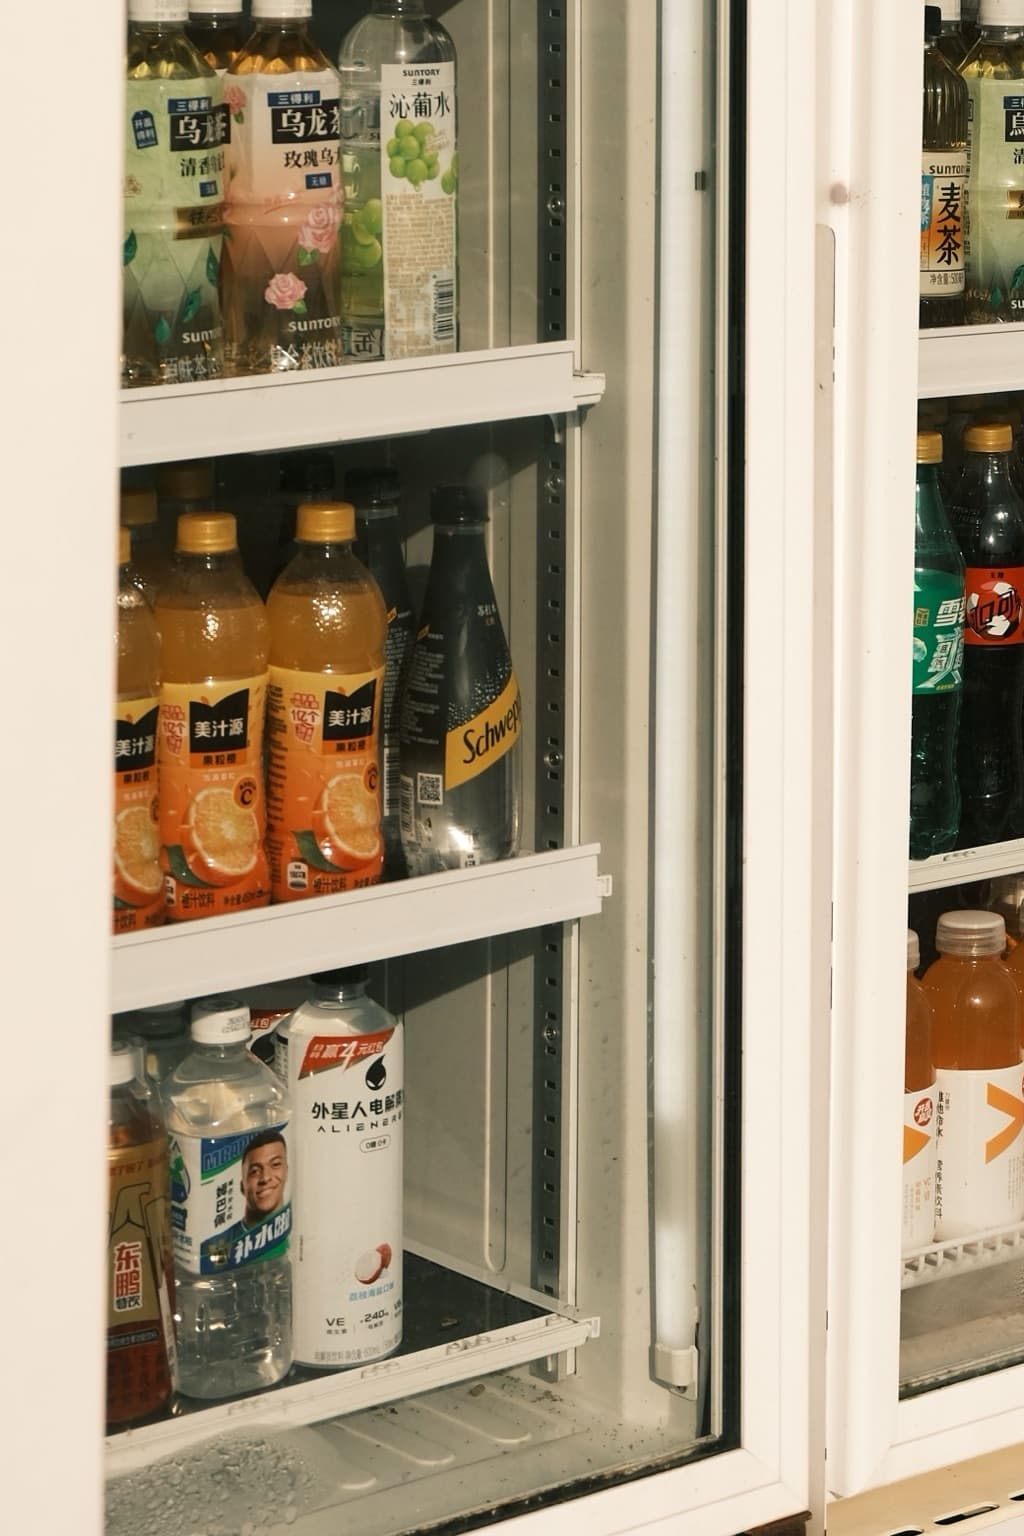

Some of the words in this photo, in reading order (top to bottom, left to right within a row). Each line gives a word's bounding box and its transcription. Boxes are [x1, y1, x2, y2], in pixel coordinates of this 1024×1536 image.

[402, 68, 440, 78] SUNTORY
[411, 78, 432, 86] 三得利
[176, 99, 210, 111] 三得利
[277, 93, 315, 105] 三得利
[389, 91, 451, 120] 沁葡水
[283, 147, 341, 169] 玫瑰乌
[935, 182, 961, 266] 麦茶
[327, 705, 373, 728] 美汁源
[194, 717, 244, 739] 美汁源
[115, 1241, 142, 1297] 东鹏
[326, 1317, 345, 1327] VE
